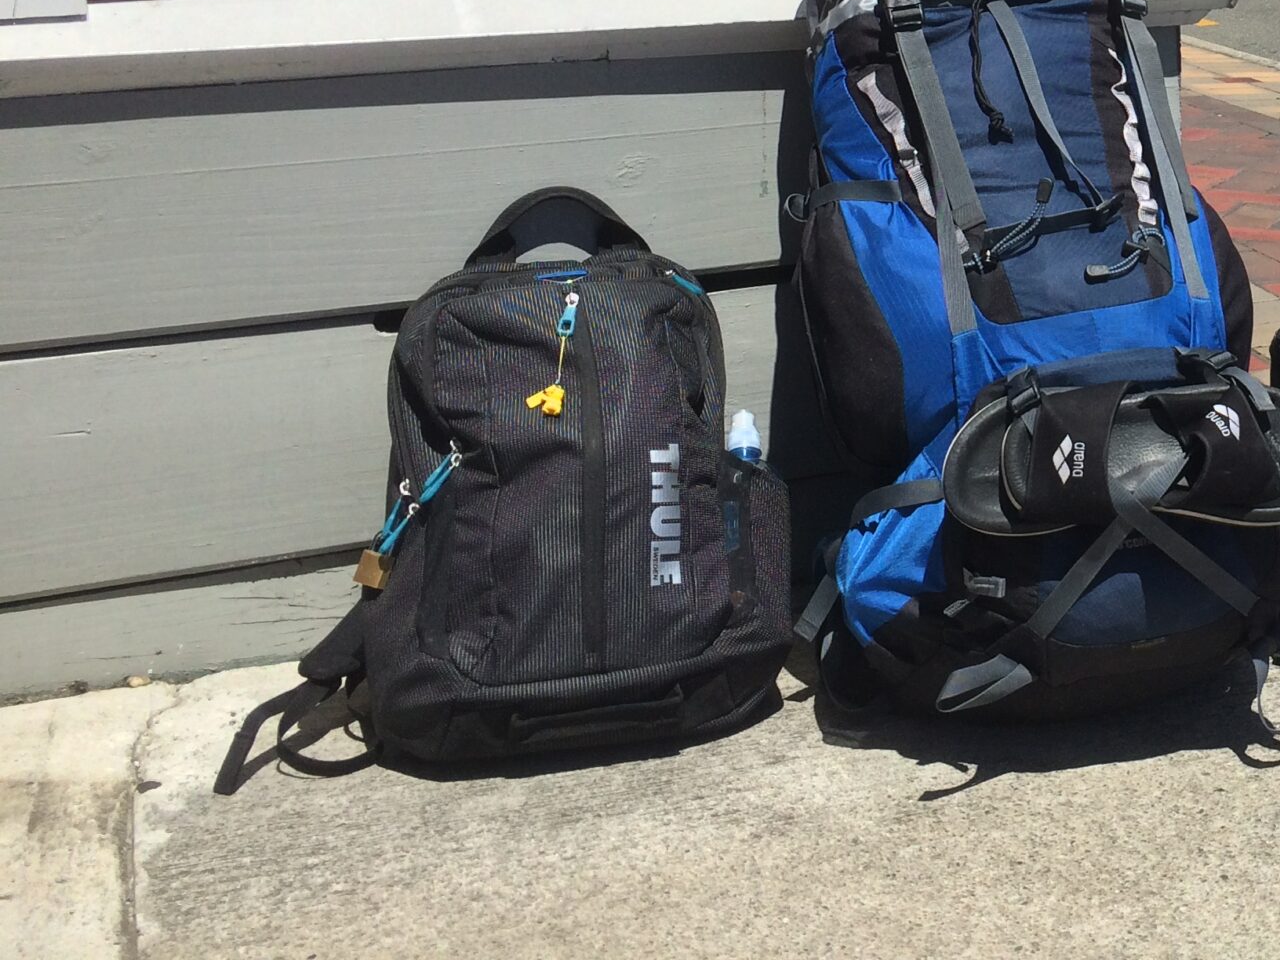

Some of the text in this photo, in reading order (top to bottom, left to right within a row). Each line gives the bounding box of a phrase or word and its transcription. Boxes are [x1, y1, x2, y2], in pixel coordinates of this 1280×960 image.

[1205, 411, 1231, 437] arena
[1072, 442, 1086, 477] arena
[650, 443, 682, 586] THULE
